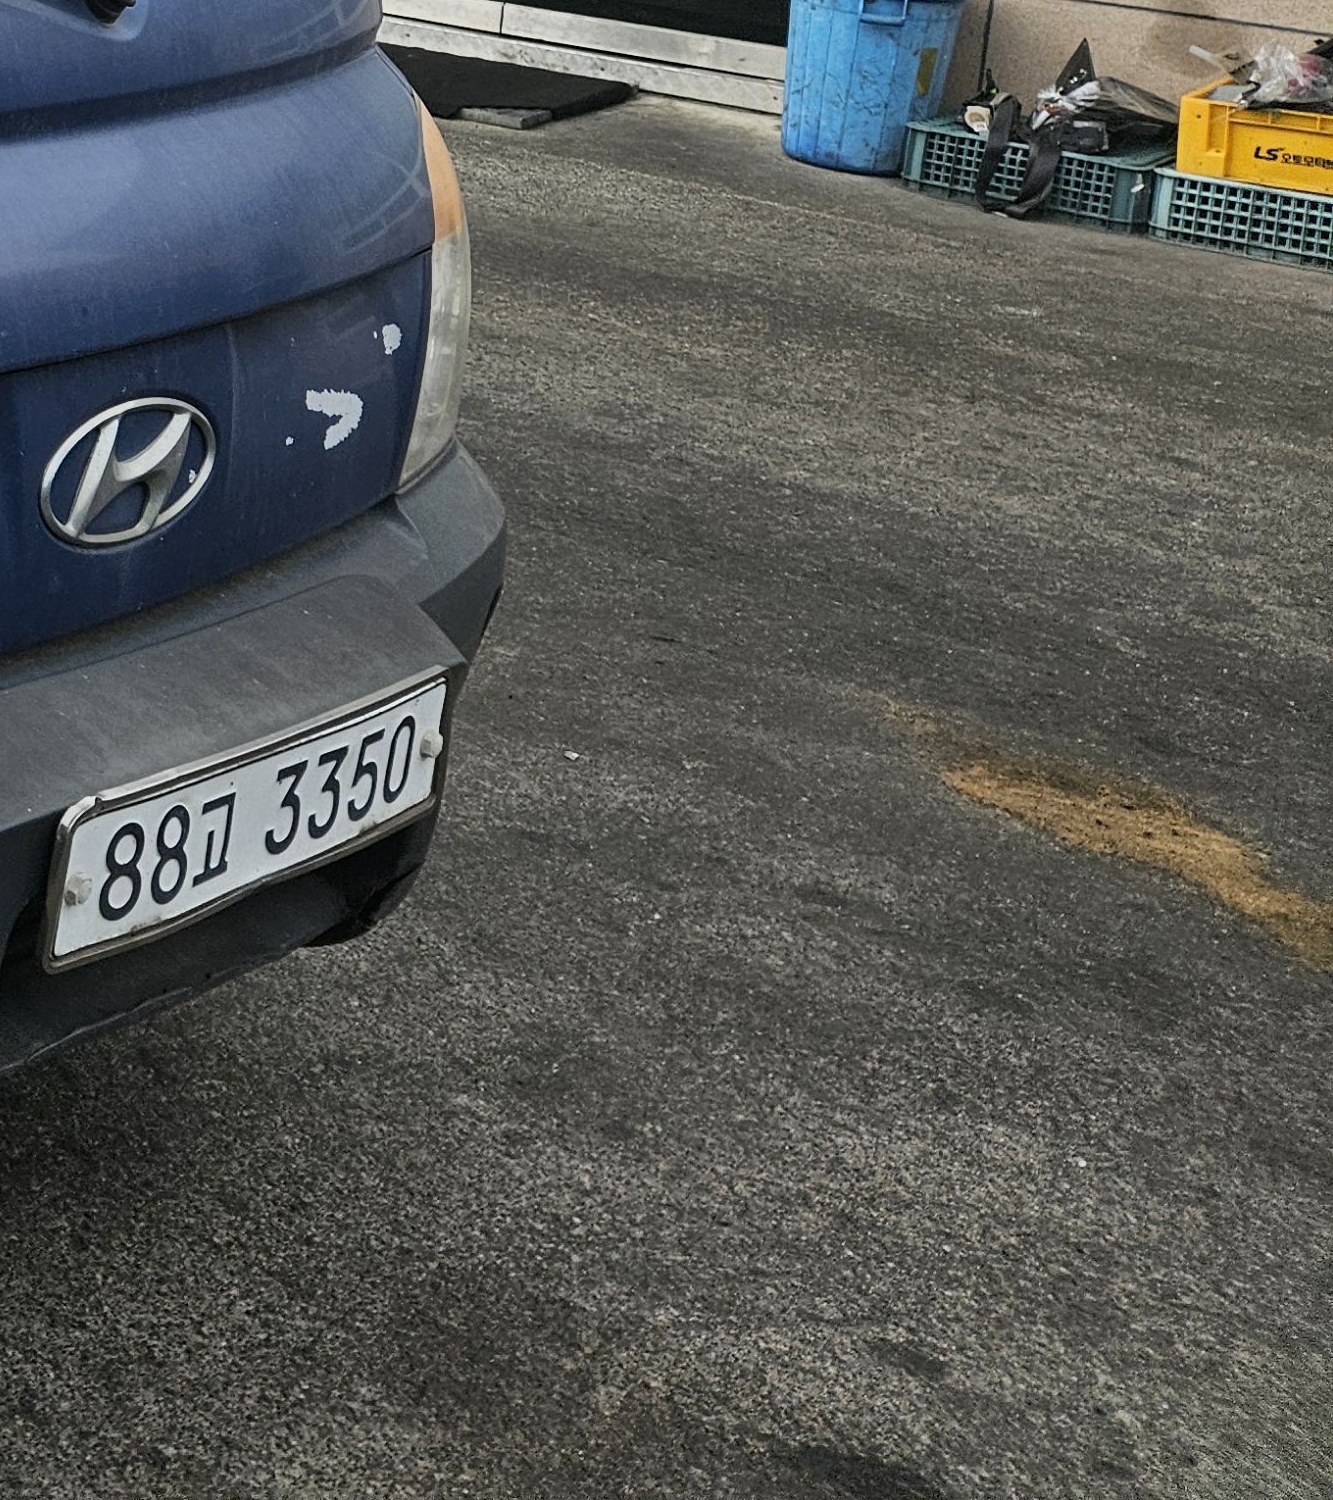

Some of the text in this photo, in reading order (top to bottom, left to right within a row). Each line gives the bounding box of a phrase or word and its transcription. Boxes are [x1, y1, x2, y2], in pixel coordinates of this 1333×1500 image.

[1254, 146, 1279, 161] LS
[99, 715, 416, 921] 88고 3350
